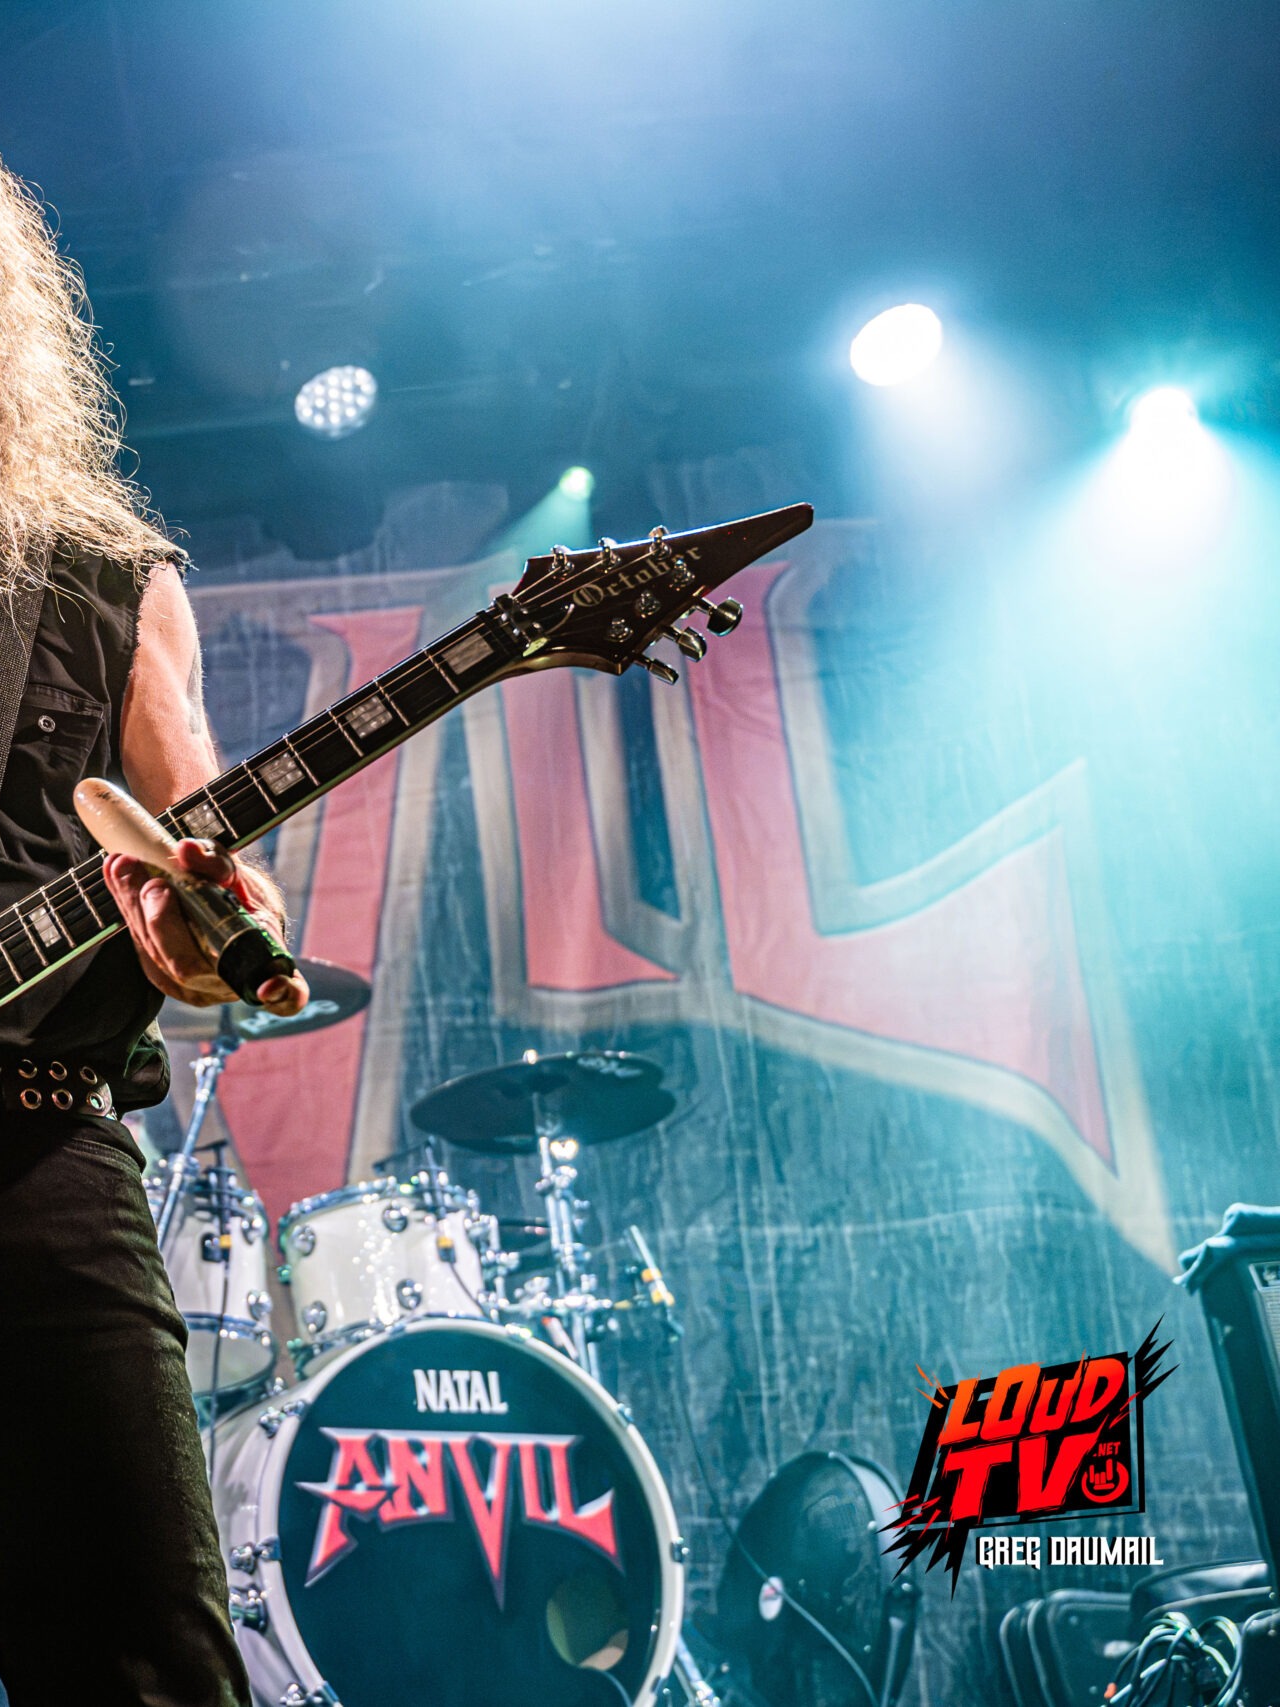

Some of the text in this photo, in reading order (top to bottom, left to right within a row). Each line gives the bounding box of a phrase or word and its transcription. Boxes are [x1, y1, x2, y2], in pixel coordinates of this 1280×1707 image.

[572, 546, 702, 608] Octobr
[413, 1368, 508, 1415] NATAL
[295, 1426, 624, 1611] ANVIL
